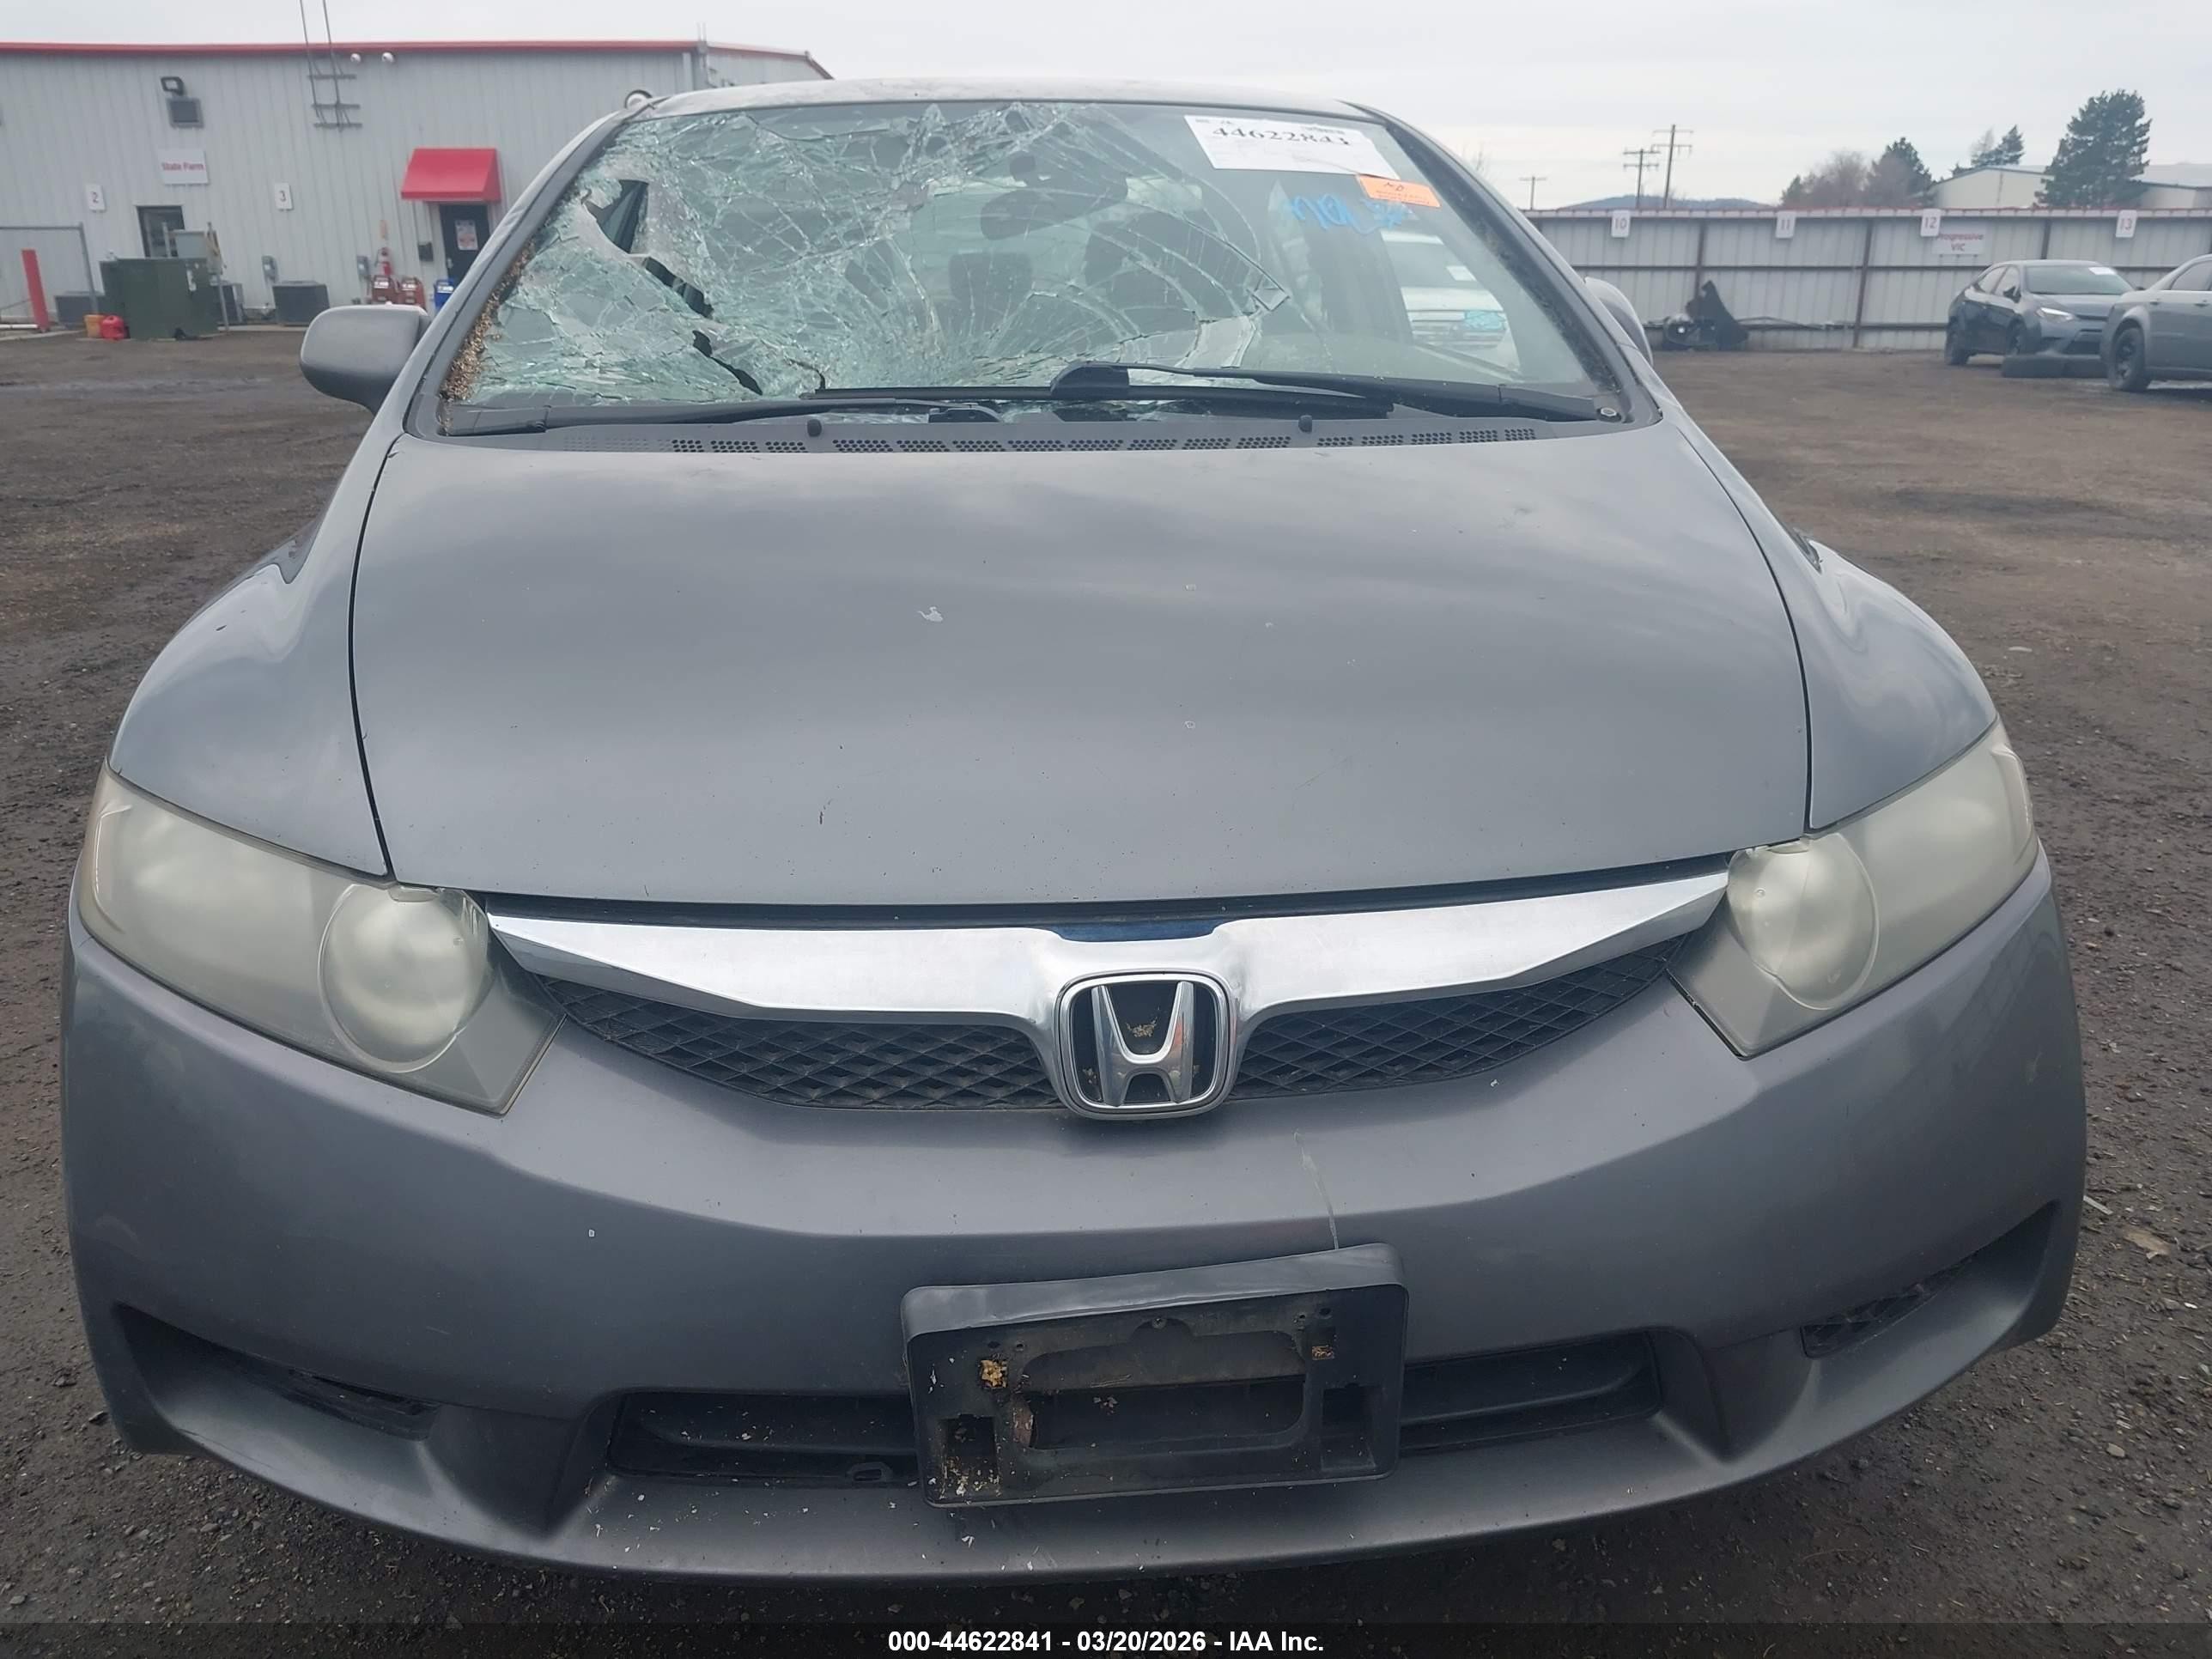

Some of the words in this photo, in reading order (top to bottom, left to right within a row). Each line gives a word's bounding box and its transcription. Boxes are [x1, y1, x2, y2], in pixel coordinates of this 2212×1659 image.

[161, 161, 181, 171] State
[184, 161, 204, 171] Farm
[91, 191, 100, 204] 2
[278, 190, 288, 203] 3
[1614, 217, 1627, 230] 10
[1779, 218, 1791, 231] 11
[1924, 216, 1938, 229] 12
[2120, 218, 2133, 231] 13
[1950, 242, 1966, 252] VIC
